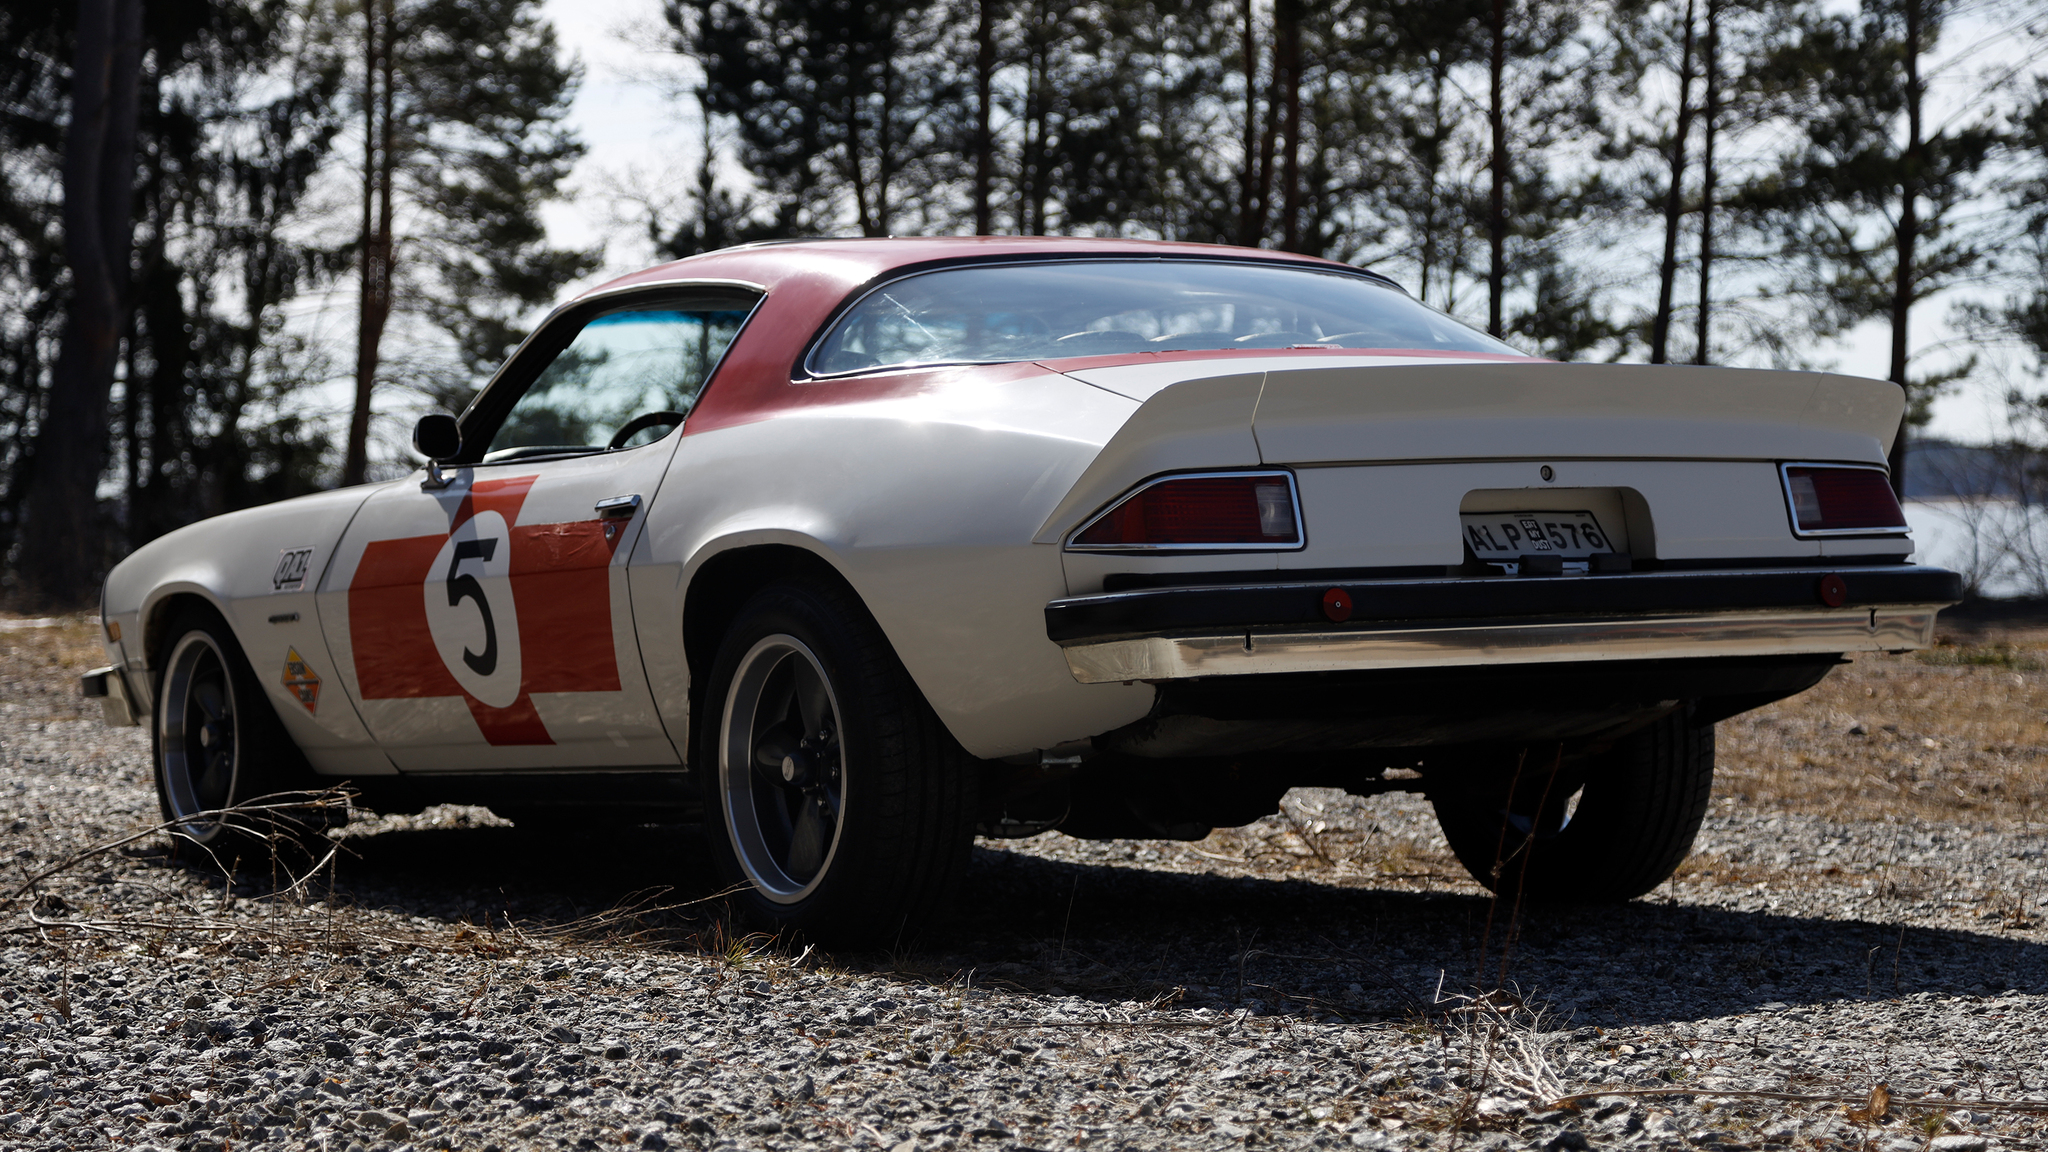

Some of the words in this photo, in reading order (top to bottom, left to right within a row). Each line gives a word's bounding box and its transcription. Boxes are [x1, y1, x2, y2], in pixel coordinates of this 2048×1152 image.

[1522, 520, 1538, 529] EAT
[1468, 523, 1521, 551] ALP
[1545, 522, 1604, 549] 576
[1529, 530, 1541, 538] MY
[1532, 539, 1551, 550] DUST
[447, 538, 499, 676] 5
